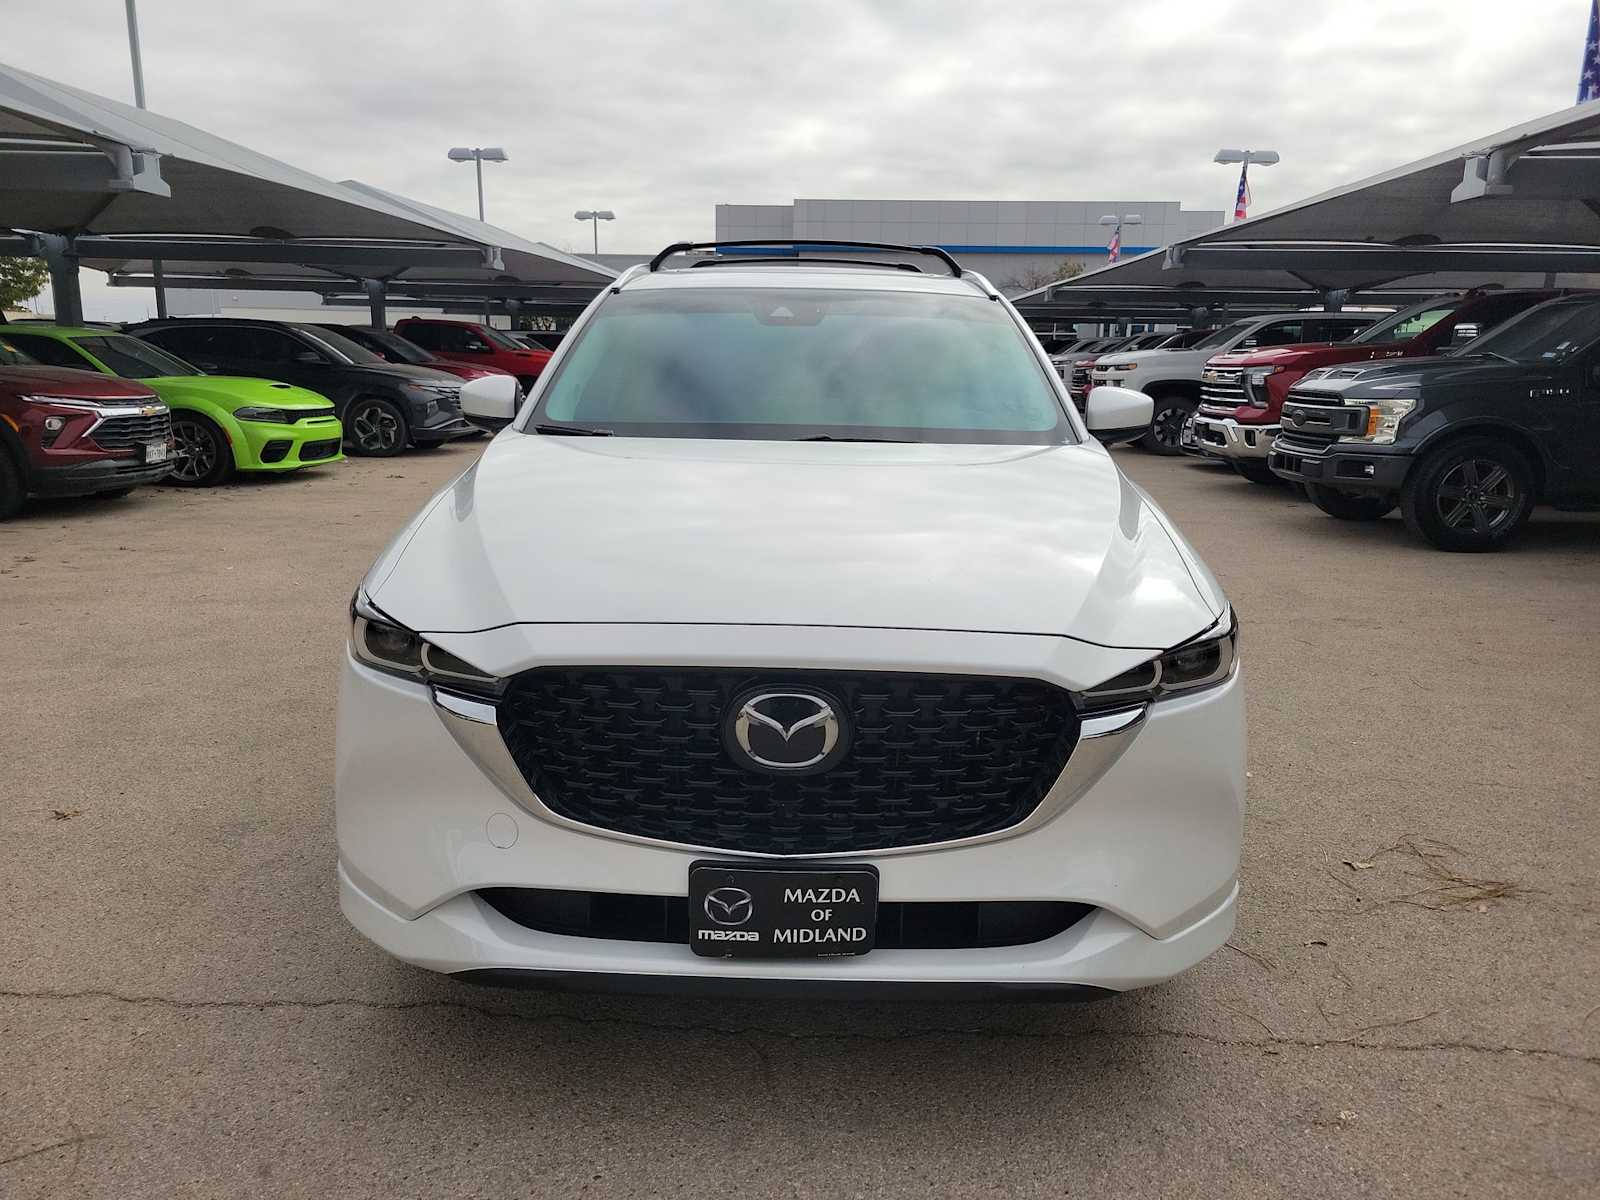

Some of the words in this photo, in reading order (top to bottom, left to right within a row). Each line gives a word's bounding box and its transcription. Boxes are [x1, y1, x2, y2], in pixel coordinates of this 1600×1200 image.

[784, 888, 861, 903] MAZDA
[810, 909, 833, 922] OF
[773, 927, 867, 944] MIDLAND
